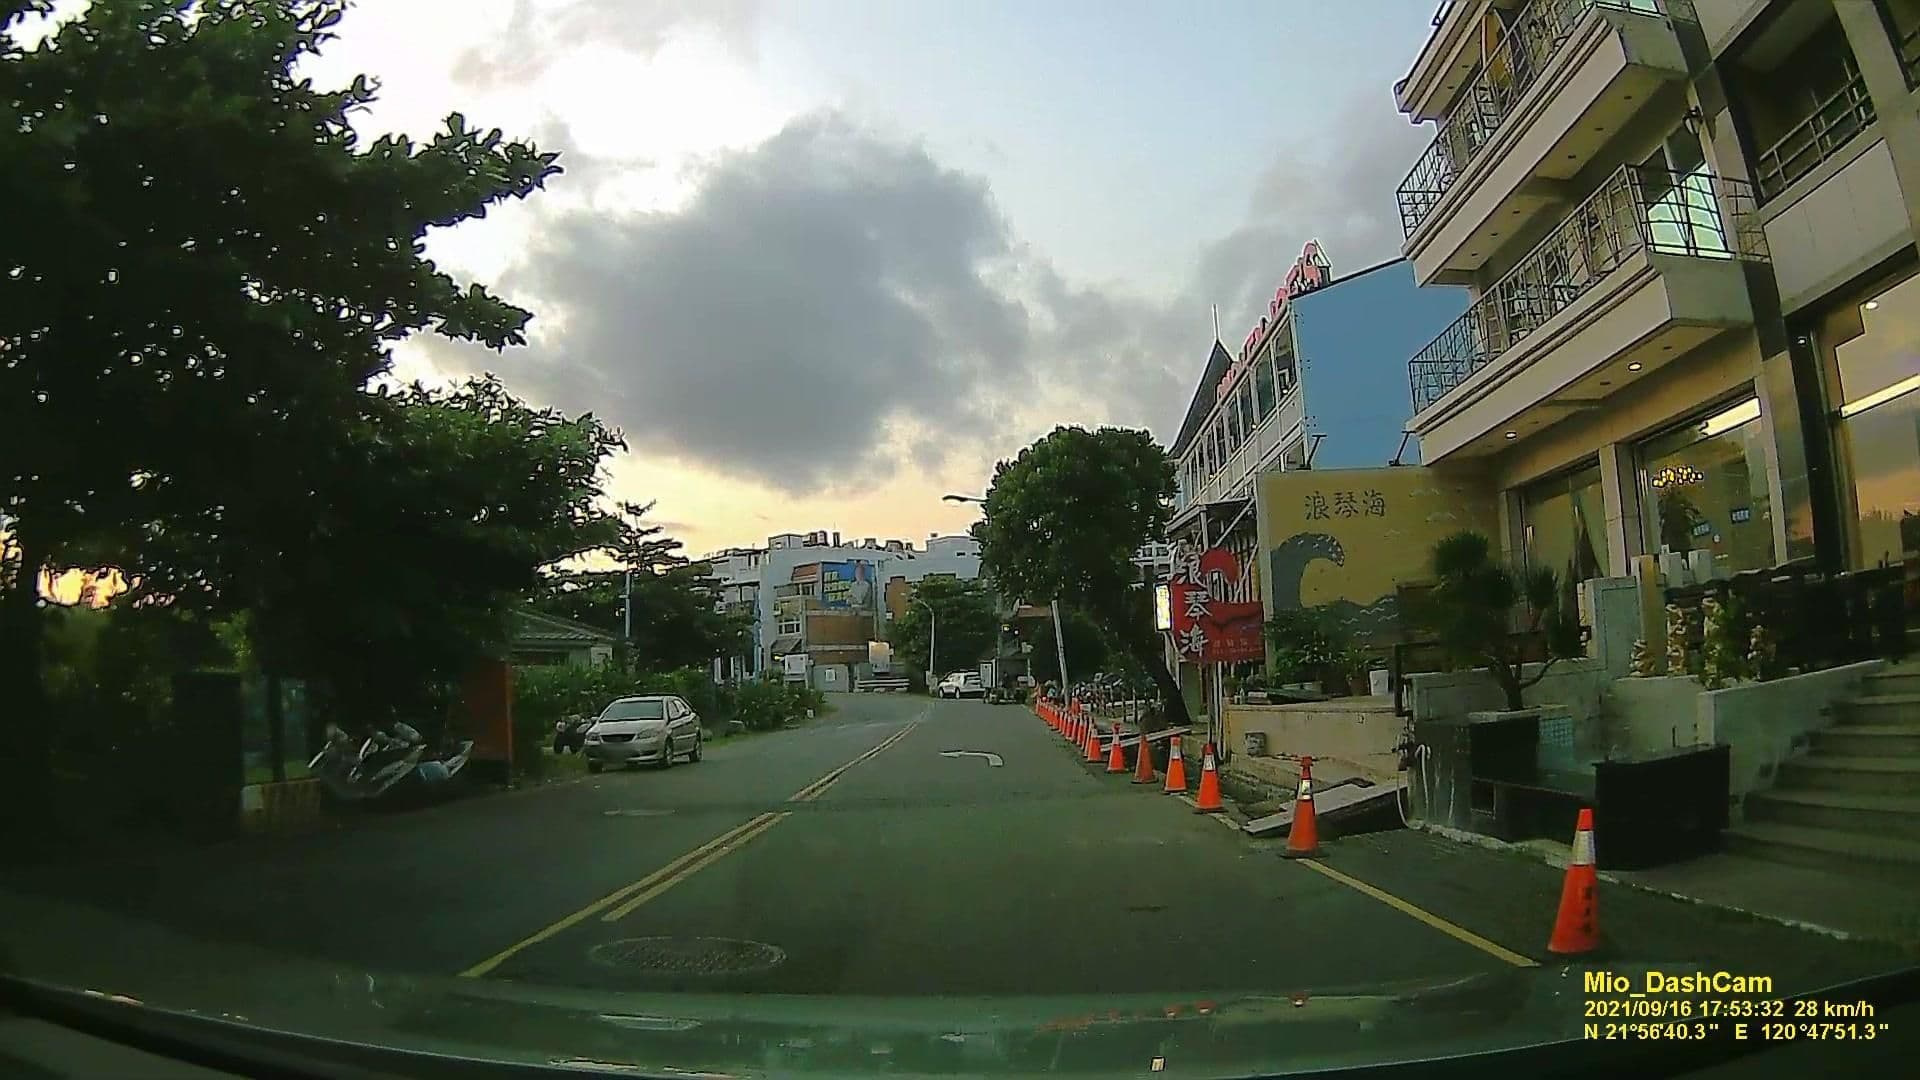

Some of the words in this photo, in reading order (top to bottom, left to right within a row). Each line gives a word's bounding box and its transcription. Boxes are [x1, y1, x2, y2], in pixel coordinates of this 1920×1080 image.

[1304, 488, 1386, 521] 浪琴海
[1173, 547, 1212, 658] 浪琴海
